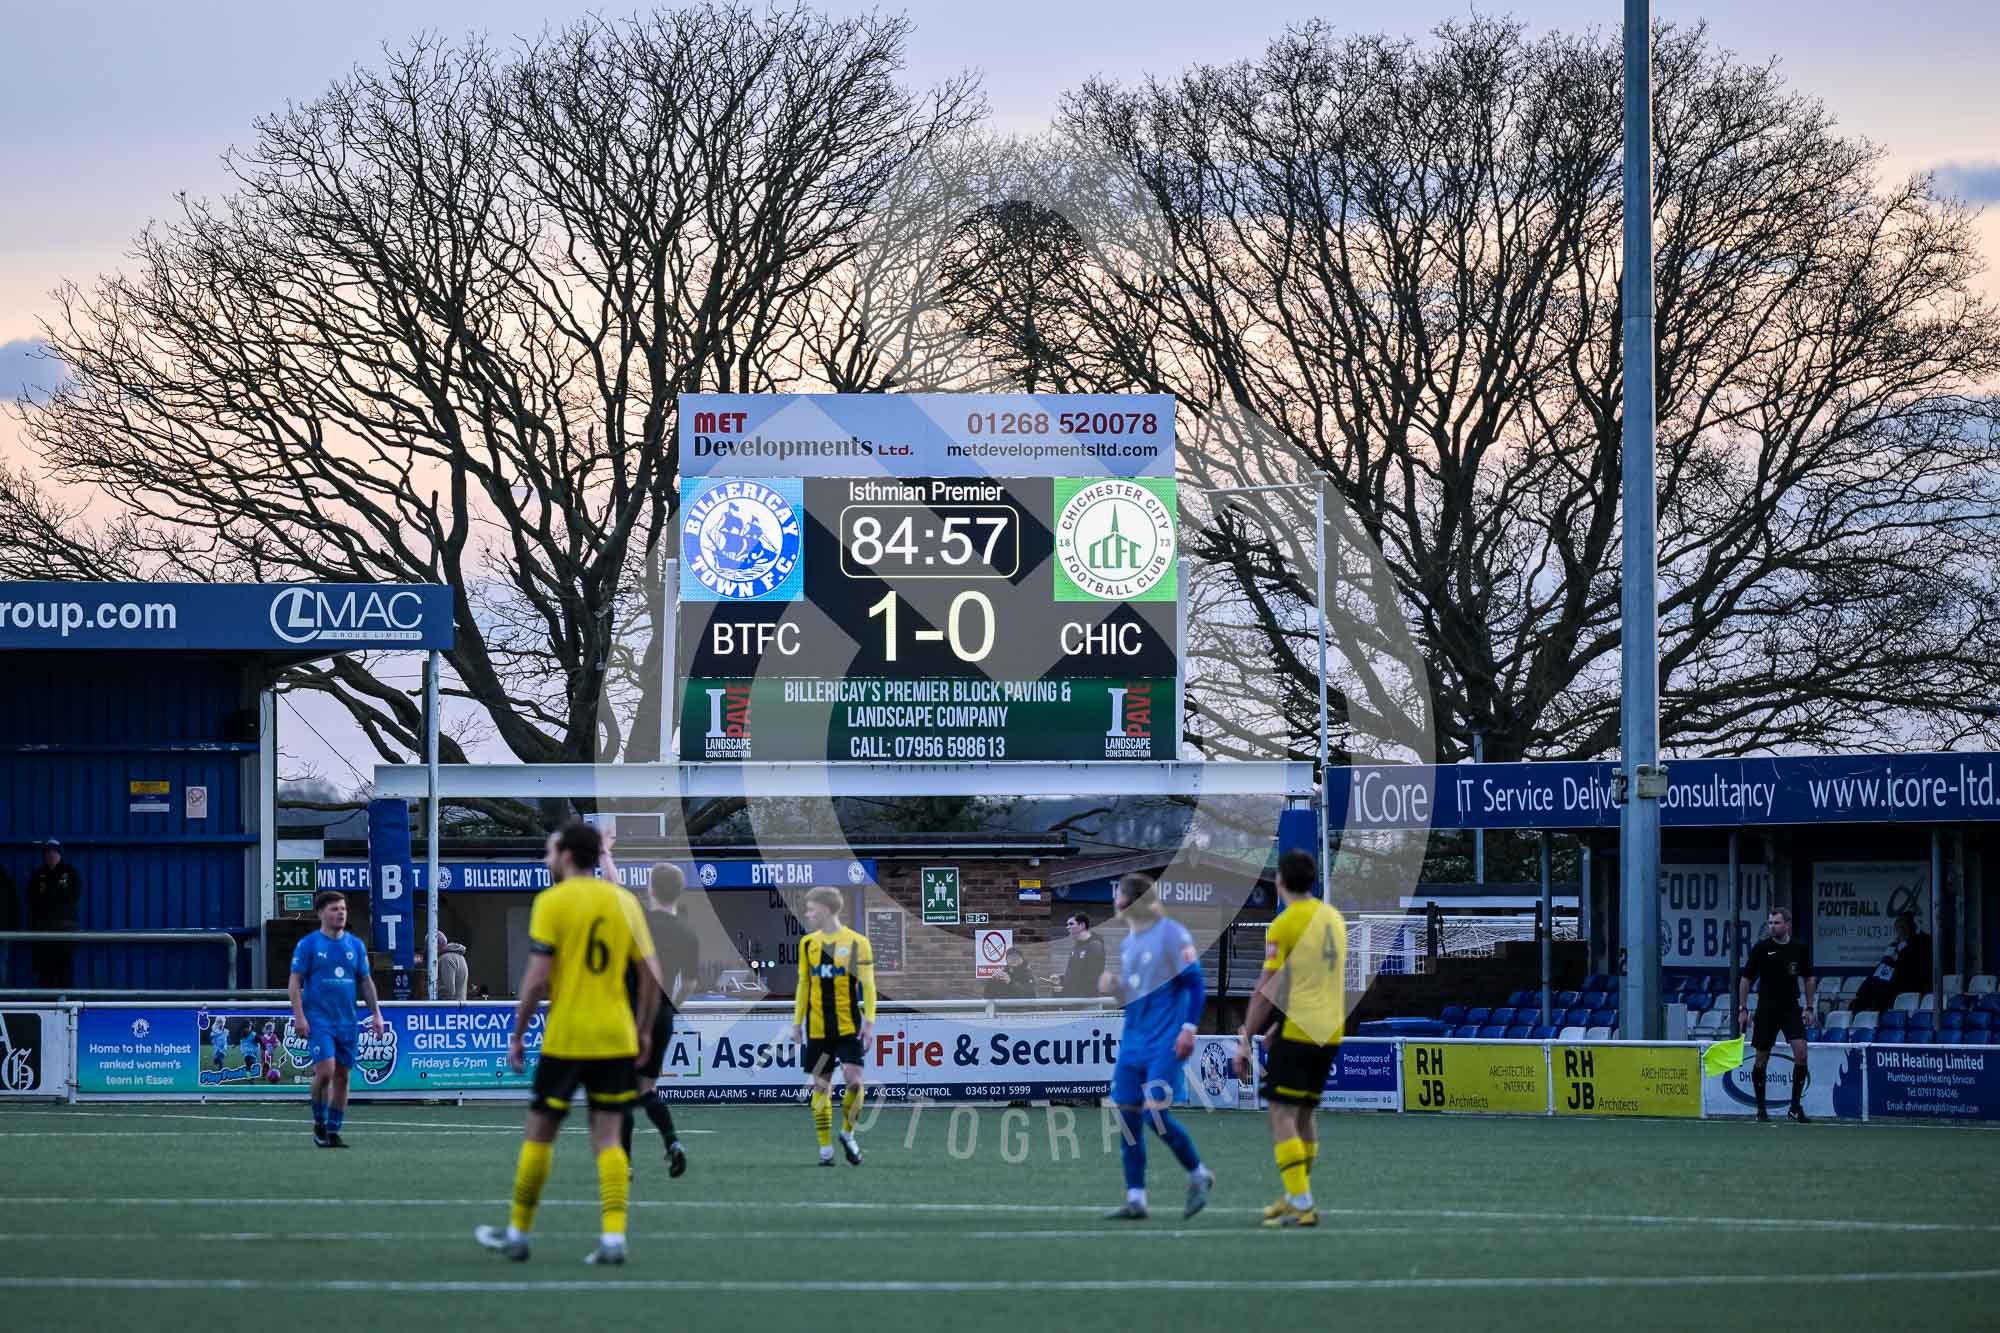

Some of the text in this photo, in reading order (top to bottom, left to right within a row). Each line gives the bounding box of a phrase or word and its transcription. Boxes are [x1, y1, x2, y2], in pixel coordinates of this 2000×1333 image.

[694, 412, 748, 433] MET
[967, 412, 1158, 434] 01268 520078
[694, 435, 914, 461] Developments Ltd.
[947, 442, 1158, 460] metdevelopmentsltd.com
[850, 481, 1005, 501] Isthmian Premier
[684, 482, 799, 537] BILLERICAY
[1062, 484, 1169, 530] CHICHESTER CITY
[851, 516, 1009, 566] 84:57
[1059, 539, 1071, 547] 18
[690, 553, 797, 598] TOWN F.C.
[1064, 555, 1166, 596] FOOTBALL CLUB
[868, 590, 996, 662] 1-0
[712, 623, 801, 655] BTFC
[1060, 622, 1143, 655] CHIC
[784, 680, 1072, 703] BILLERICAY'S PREMIER BLOCK PAVING &
[848, 706, 1009, 728] LANDSCAPE COMPANY
[705, 738, 752, 750] LANDSCAPE
[705, 750, 752, 758] CONSTRUCTION
[850, 736, 1005, 758] CALL: 07956 598613
[1105, 738, 1151, 750] LANDSCAPE
[1105, 749, 1151, 758] CONSTRUCTION
[1353, 769, 1428, 823] iCore
[1456, 779, 1474, 812] IT
[1483, 777, 1553, 813] Service
[1563, 775, 1622, 811] Deliv
[339, 868, 356, 887] FC
[464, 868, 533, 887] BILLERICAY
[535, 868, 551, 887] TO
[752, 863, 813, 884] BTFC BAR
[1175, 882, 1213, 901] SHOP
[1817, 881, 1856, 898] TOTAL
[1817, 900, 1881, 917] FOOTBALL
[586, 916, 610, 974] 6
[1322, 922, 1339, 973] 4
[1677, 918, 1696, 957] &
[779, 943, 800, 964] BLU
[407, 1014, 511, 1031] BILLERICAY
[89, 1044, 192, 1057] Home to the highest
[414, 1033, 466, 1049] GIRLS
[712, 1036, 806, 1068] Assu
[876, 1032, 944, 1067] Fire
[953, 1033, 979, 1067] &
[99, 1059, 182, 1070] ranked women's
[411, 1057, 451, 1070] Fridays
[453, 1057, 488, 1070] 6-7pm
[671, 1042, 690, 1066] A
[1416, 1048, 1444, 1076] RH
[1564, 1050, 1595, 1078] RH
[1876, 1051, 1984, 1072] DHR Heating Limited
[106, 1075, 174, 1085] team in Essex
[1887, 1072, 1916, 1084] Plumbing
[1917, 1073, 1928, 1082] and
[1928, 1073, 1952, 1086] Heating
[658, 1089, 706, 1099] INTRUDER
[708, 1089, 748, 1098] ALARMS
[758, 1089, 778, 1098] FIRE
[781, 1088, 814, 1098] ALARM
[873, 1087, 906, 1097] ACCESS
[909, 1086, 952, 1097] CONTROL
[965, 1086, 988, 1096] 0345
[989, 1086, 1006, 1096] 021
[1009, 1085, 1032, 1095] 5999
[1418, 1080, 1445, 1107] JB
[1449, 1094, 1489, 1109] Architects
[1567, 1082, 1595, 1110] JB
[1598, 1096, 1639, 1112] Architects
